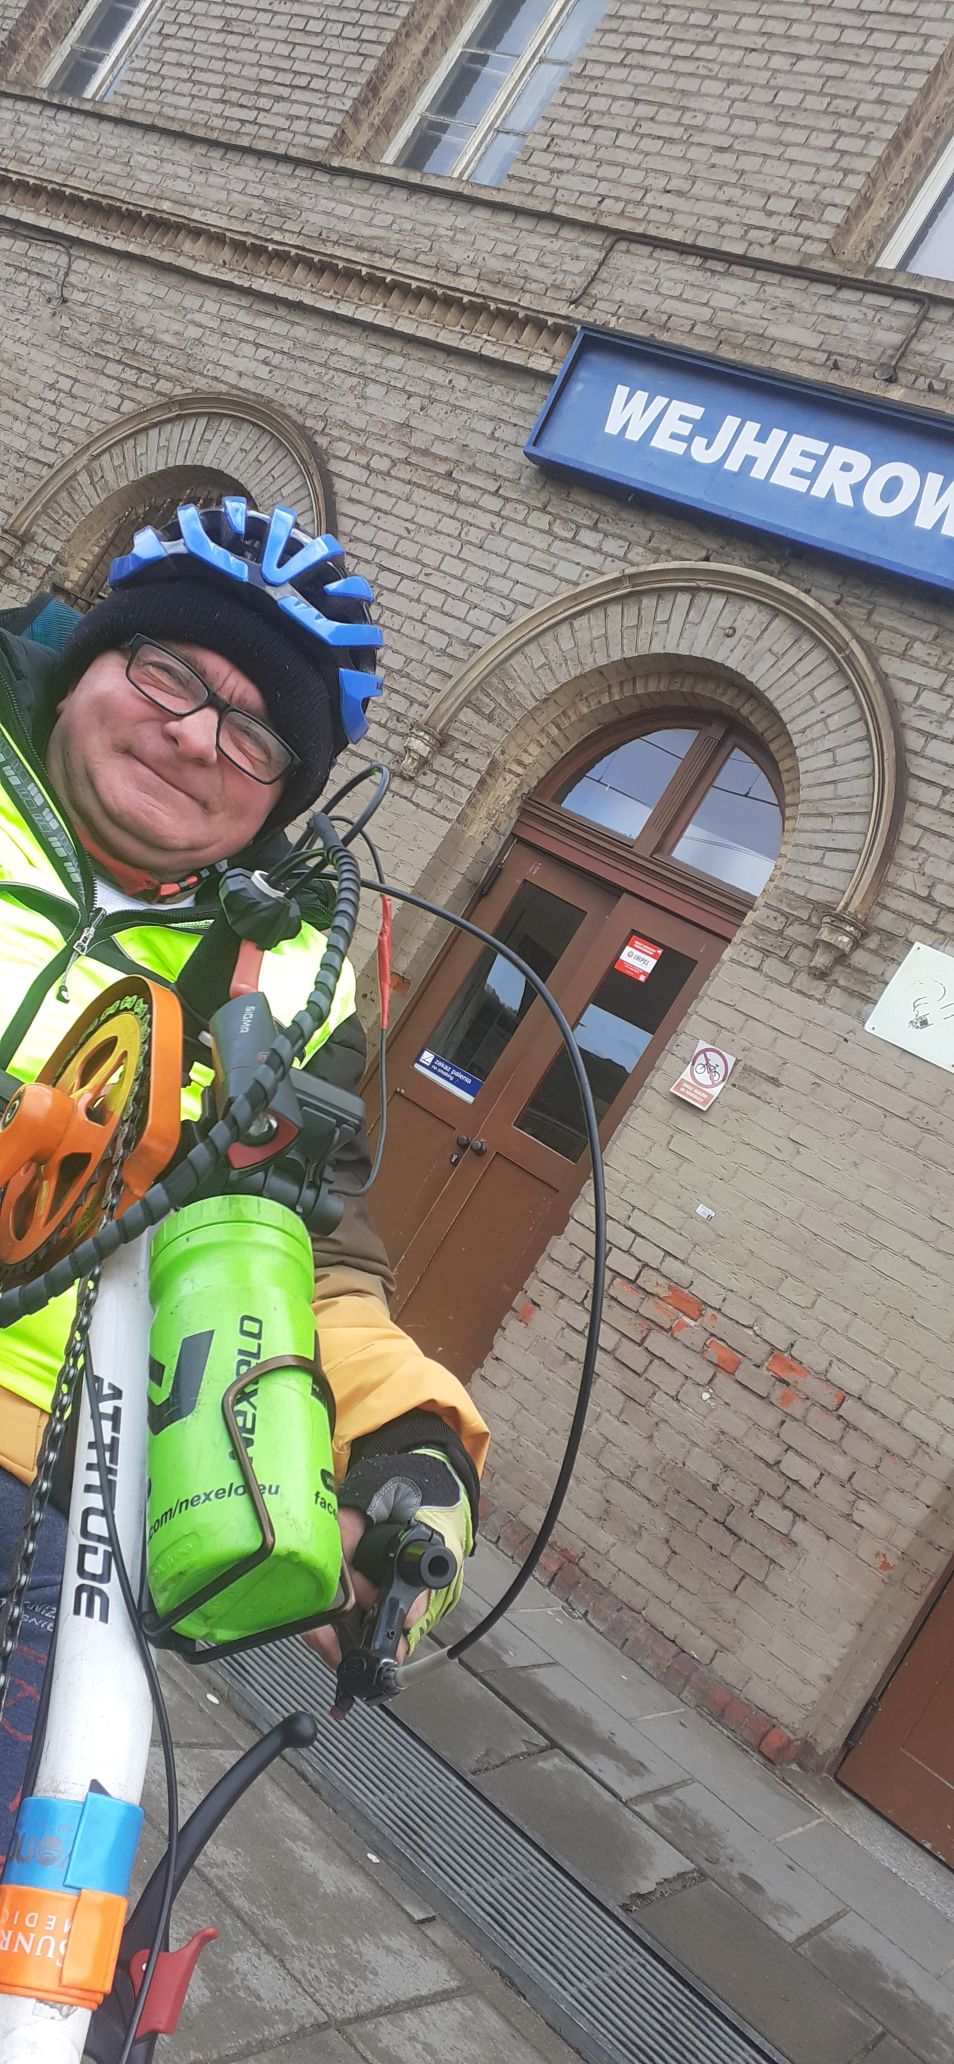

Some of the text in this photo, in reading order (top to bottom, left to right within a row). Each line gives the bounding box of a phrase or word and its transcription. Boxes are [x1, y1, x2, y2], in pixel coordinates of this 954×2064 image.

[239, 1005, 256, 1034] SIGMA
[434, 1059, 472, 1084] zakaz palenia
[73, 1374, 123, 1625] ATTITUDE
